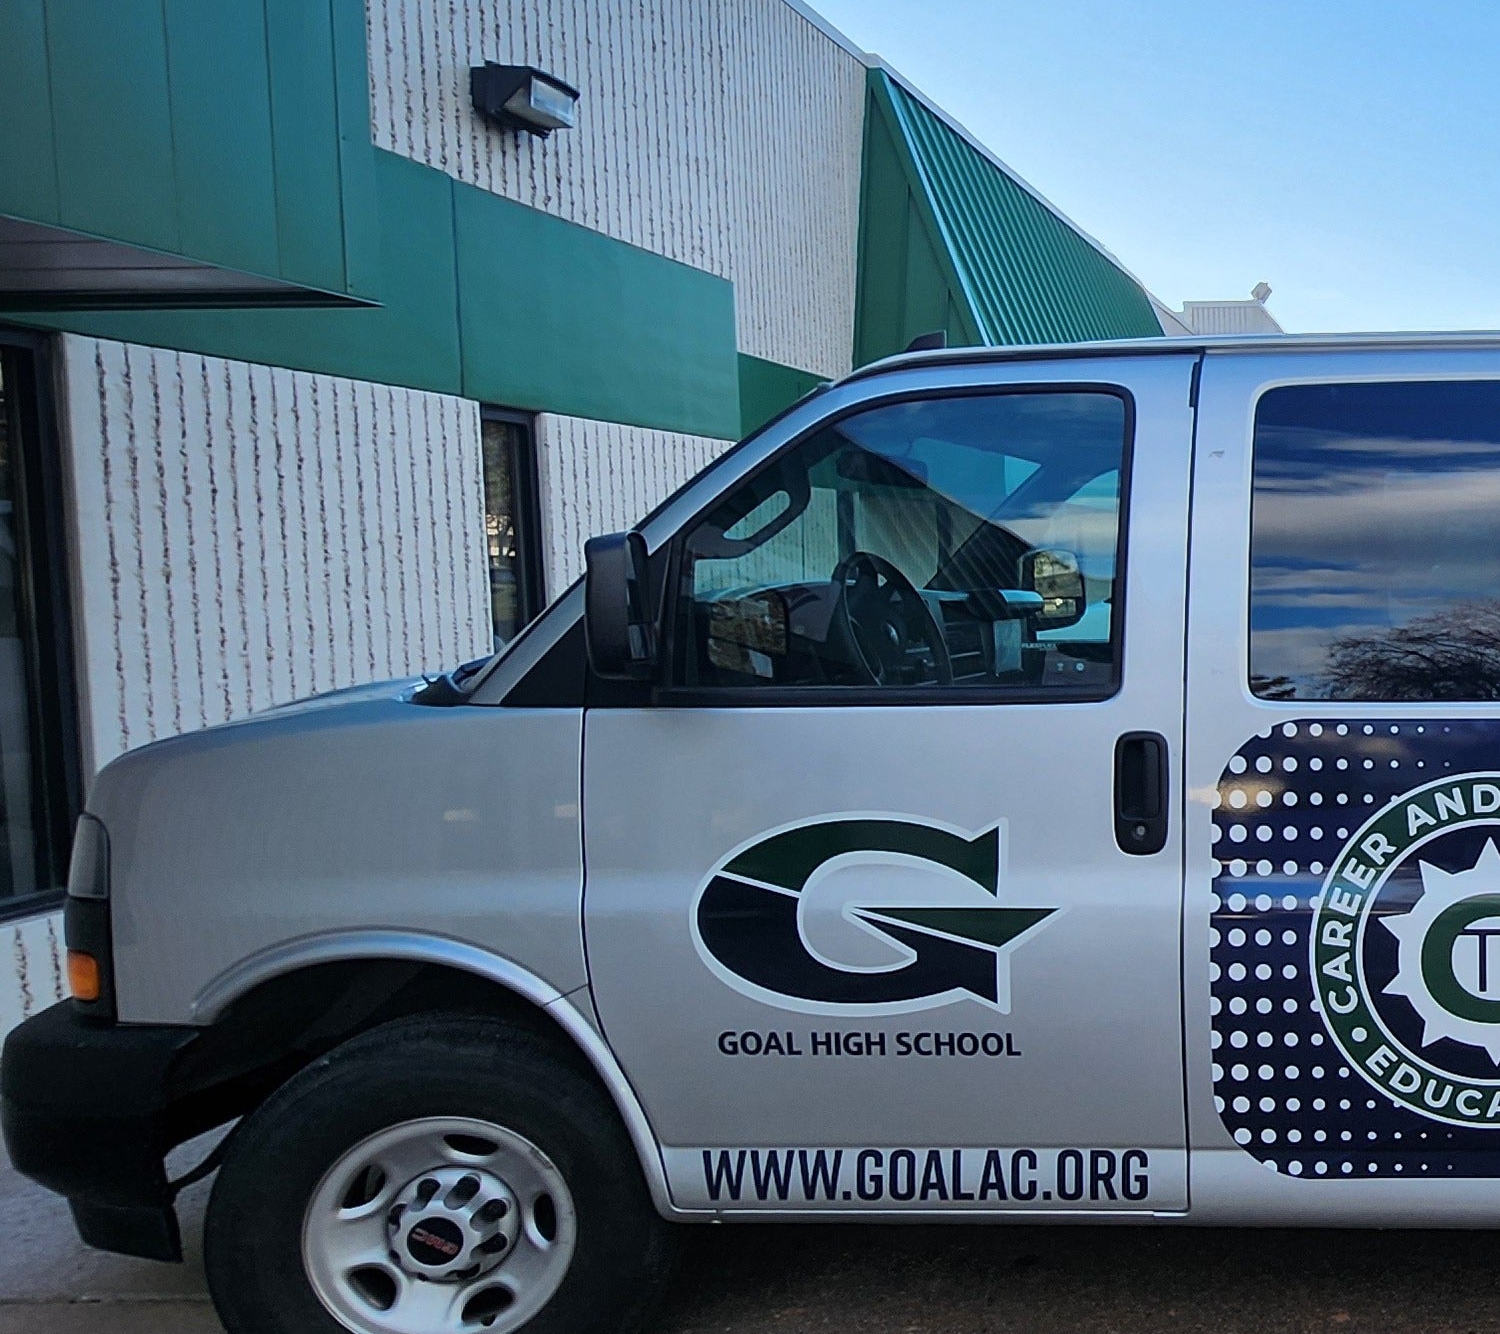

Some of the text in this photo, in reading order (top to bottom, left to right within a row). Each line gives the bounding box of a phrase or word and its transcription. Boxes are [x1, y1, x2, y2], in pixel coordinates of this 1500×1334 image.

[1322, 832, 1397, 1014] CAREER
[717, 1031, 1022, 1057] GOAL HIGH SCHOOL
[702, 1149, 1150, 1201] WWW.GOALAC.ORG
